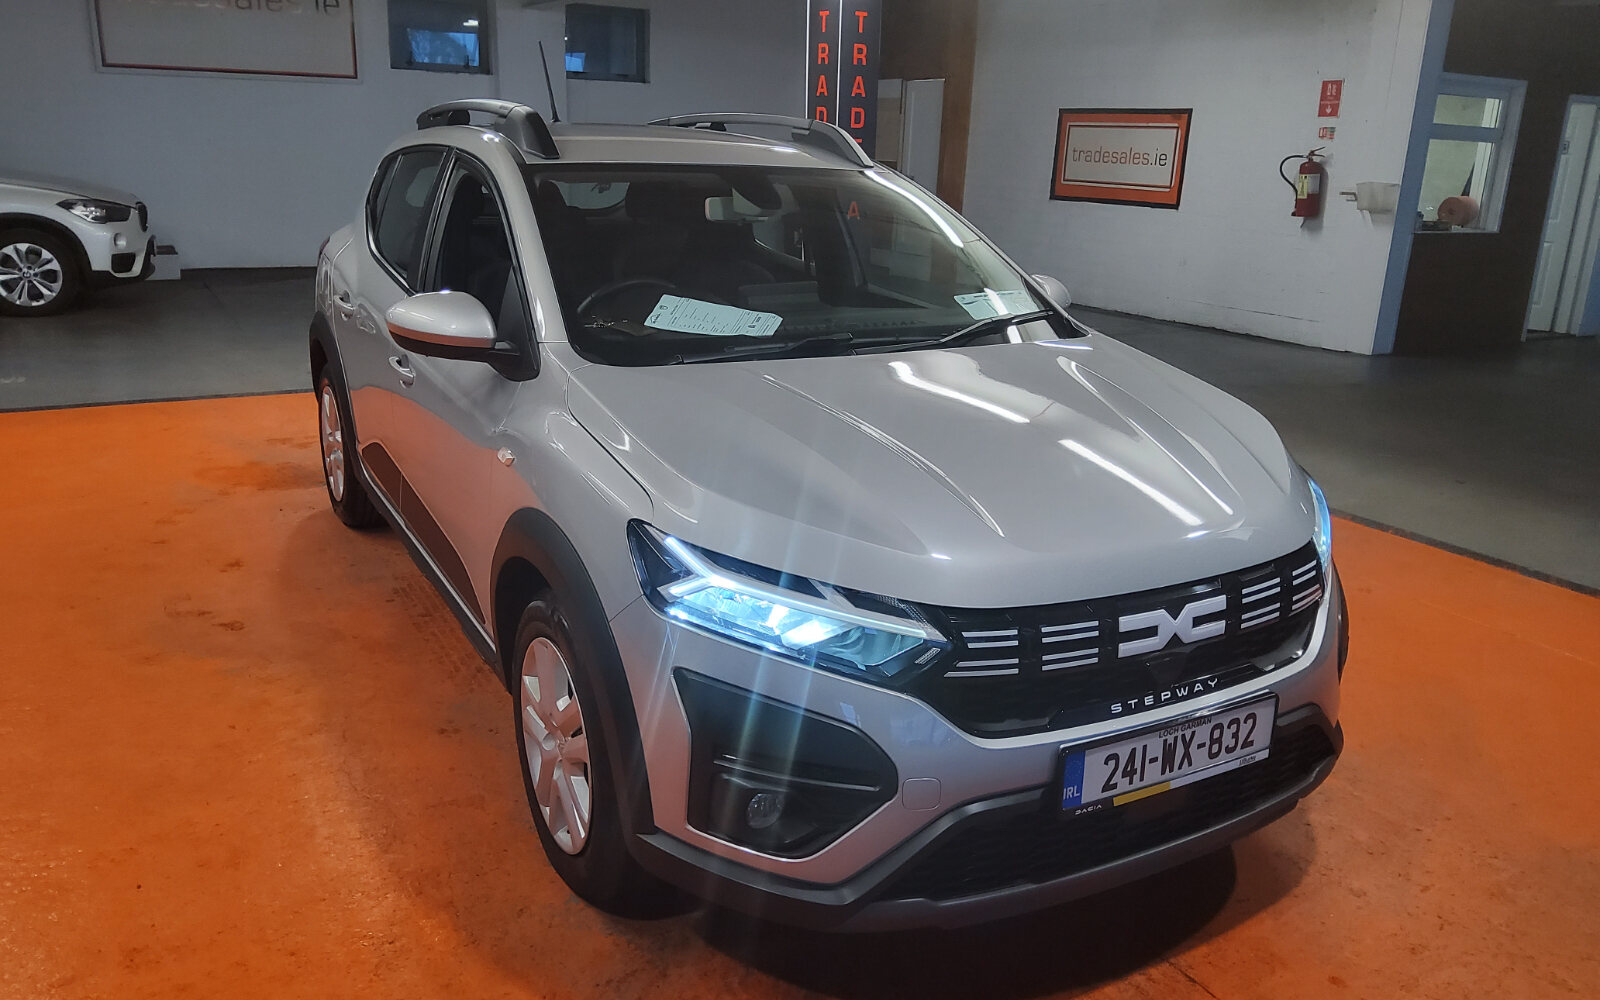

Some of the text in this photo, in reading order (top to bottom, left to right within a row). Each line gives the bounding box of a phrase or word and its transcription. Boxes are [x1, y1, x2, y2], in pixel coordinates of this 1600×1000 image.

[851, 11, 868, 143] TRAD
[1072, 146, 1168, 167] tradesales.ie
[1110, 677, 1219, 714] STEPWAY
[1158, 716, 1212, 739] LOCH GARMAN
[1101, 712, 1257, 794] 241-WX-832
[1063, 785, 1081, 801] IRL
